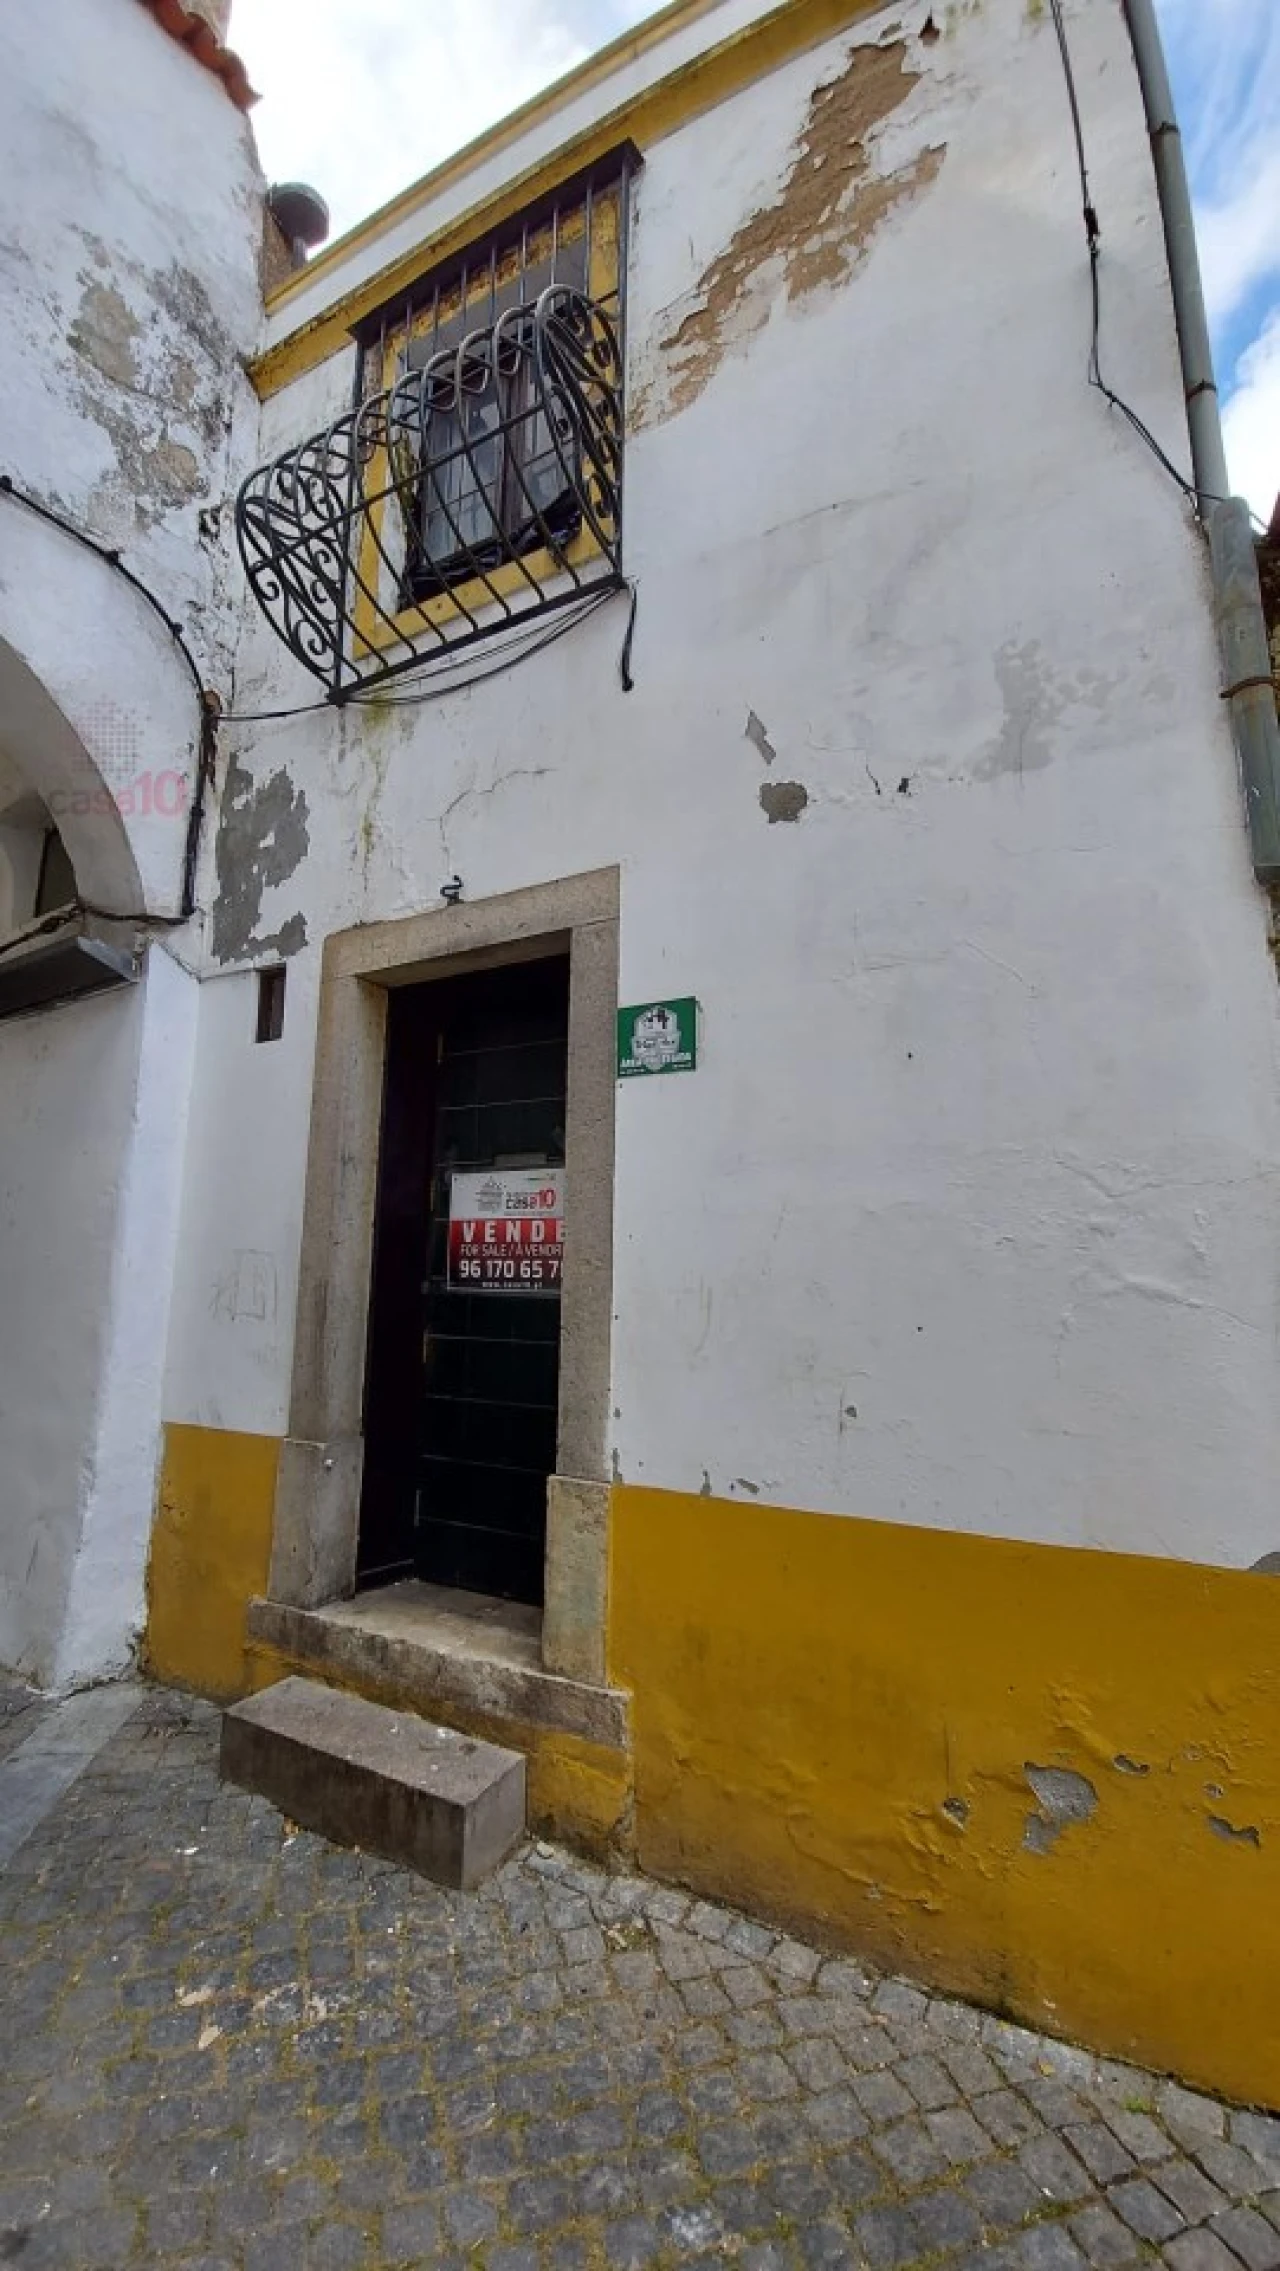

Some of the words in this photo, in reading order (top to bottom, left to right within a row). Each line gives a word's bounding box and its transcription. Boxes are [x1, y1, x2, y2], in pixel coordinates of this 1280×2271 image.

[506, 1189, 555, 1209] casa10
[461, 1244, 479, 1256] FOR
[482, 1244, 507, 1256] SALE
[526, 1244, 563, 1256] VENDR
[460, 1261, 480, 1278] 96
[487, 1261, 514, 1278] 170
[520, 1261, 542, 1278] 65
[549, 1261, 563, 1278] 7
